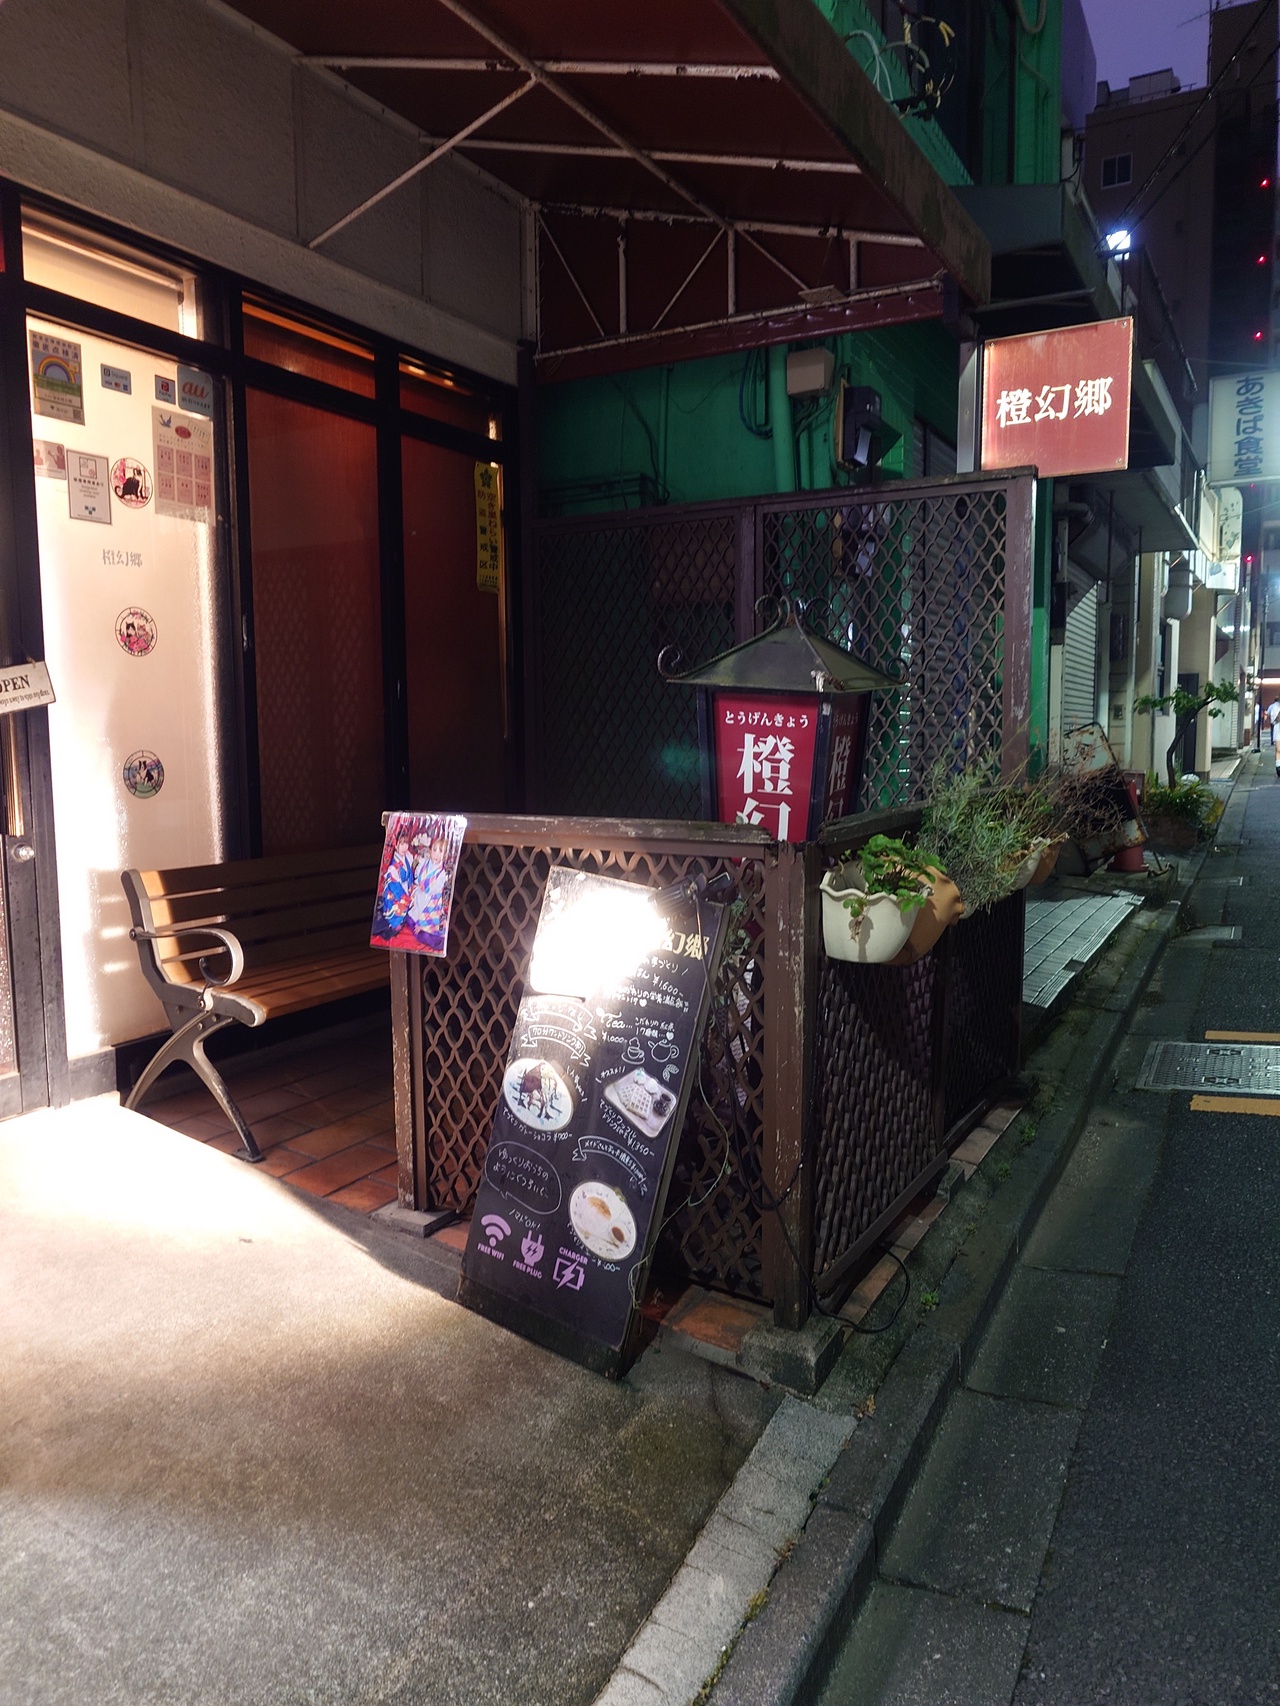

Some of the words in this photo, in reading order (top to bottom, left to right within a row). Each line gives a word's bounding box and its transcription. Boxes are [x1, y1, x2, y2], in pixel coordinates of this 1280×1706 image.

[182, 381, 209, 398] au
[995, 375, 1113, 428] 橙幻郷
[725, 710, 809, 728] とうげんきょう
[477, 1242, 491, 1255] FREE
[491, 1248, 505, 1260] WIFI
[558, 1246, 589, 1265] CHARGER
[512, 1260, 526, 1272] FREE
[526, 1266, 542, 1279] PLUG
